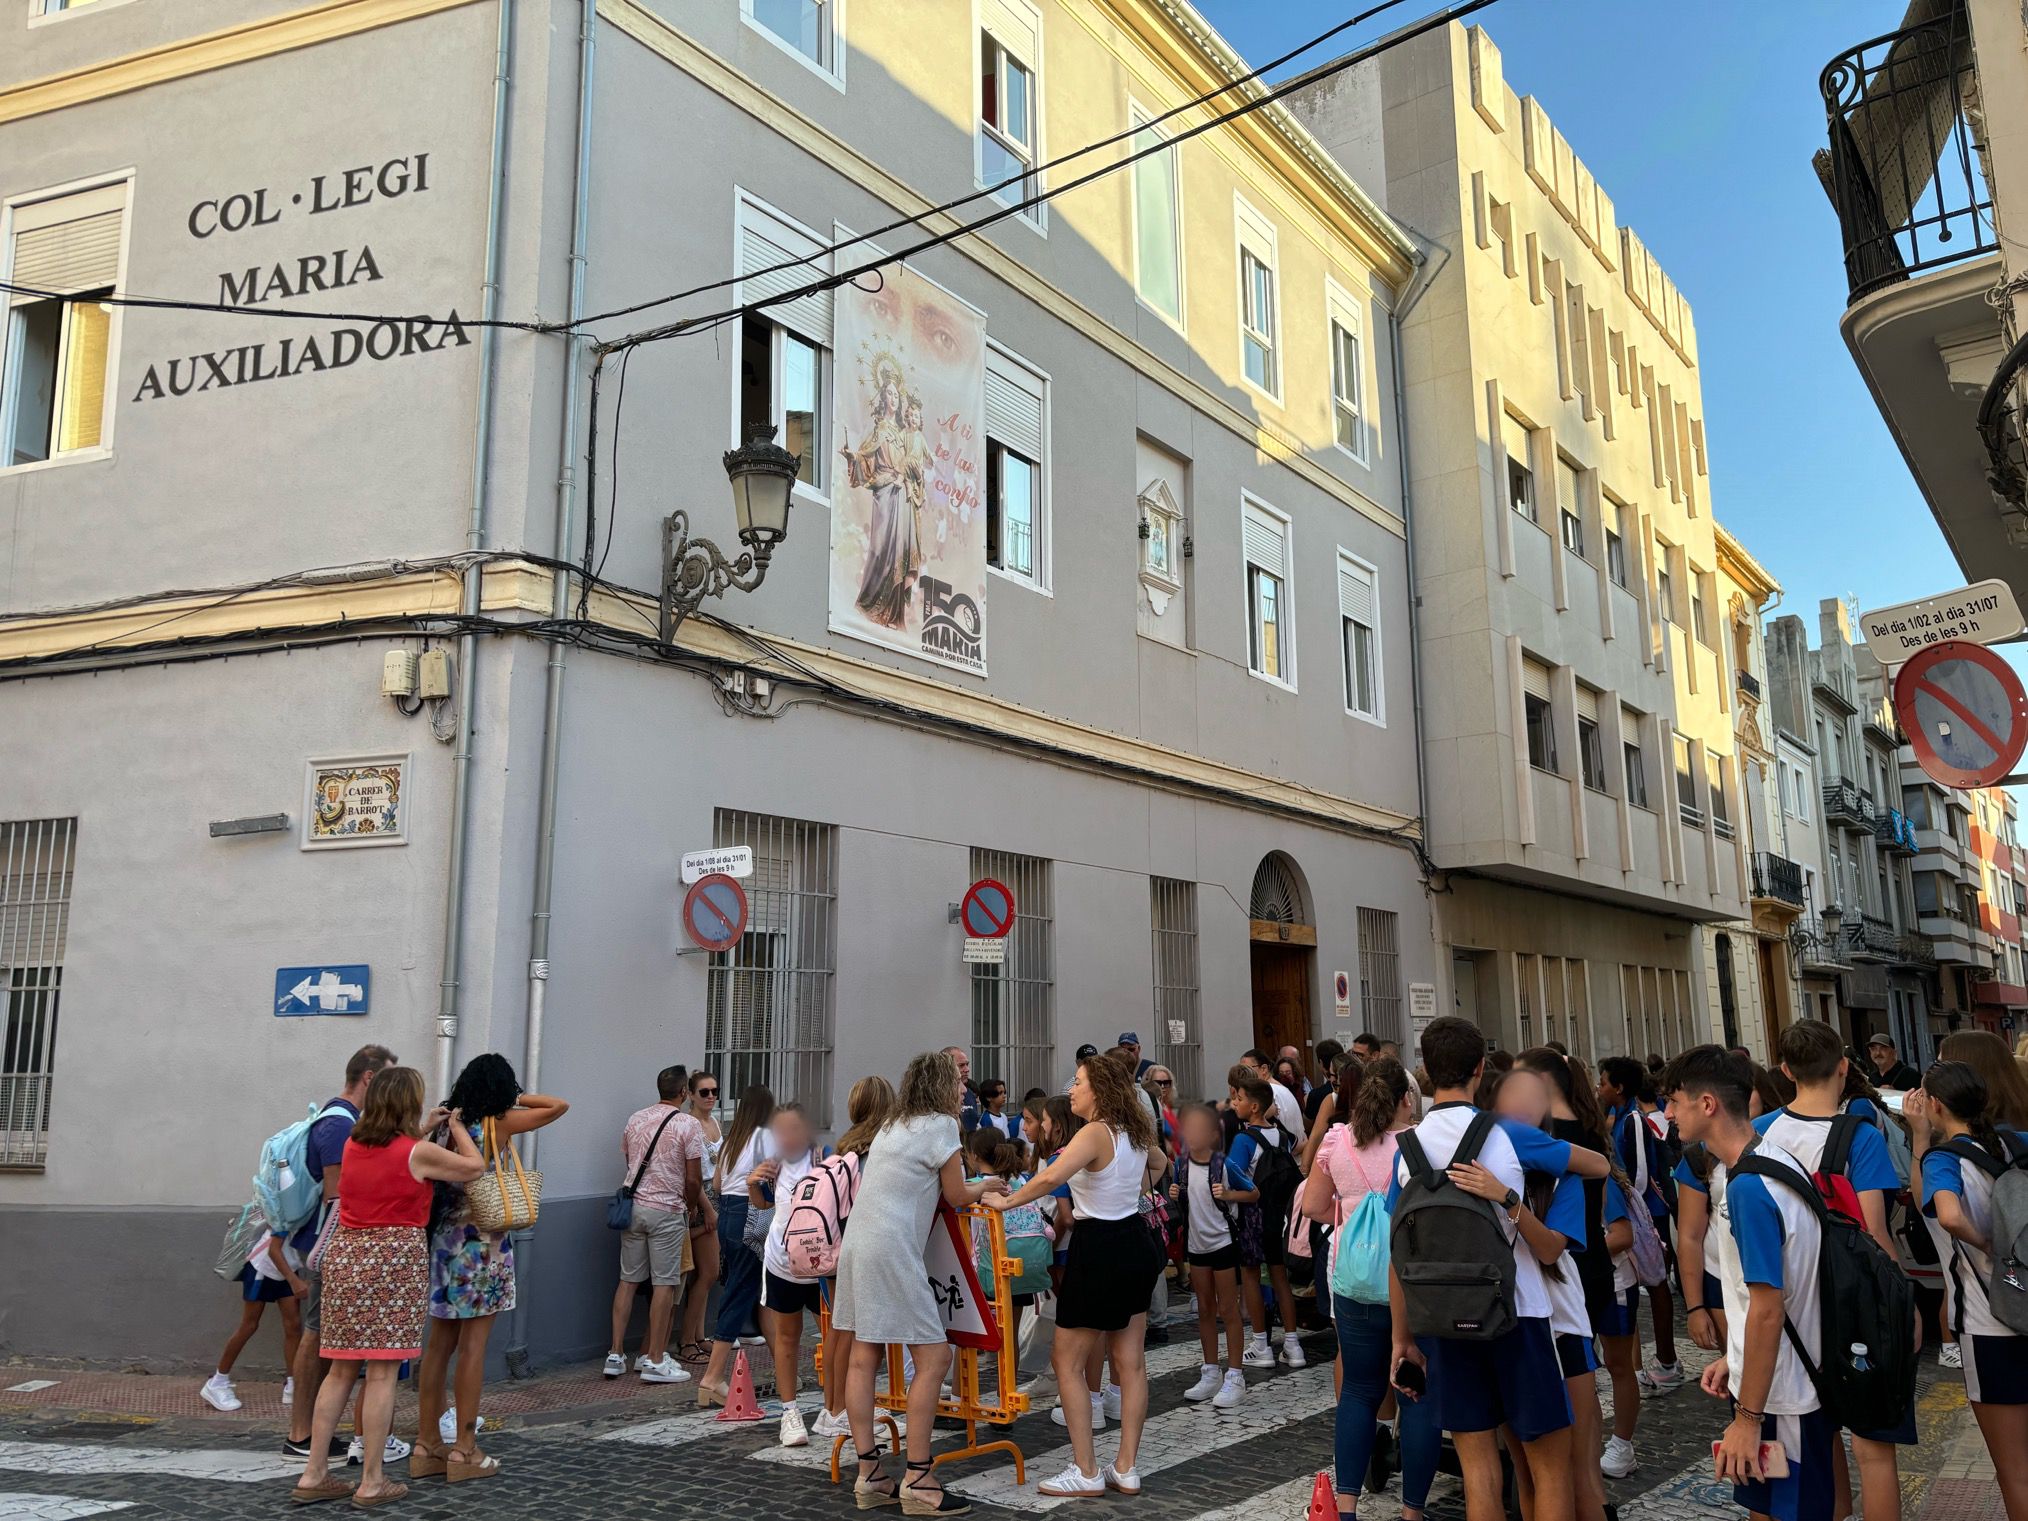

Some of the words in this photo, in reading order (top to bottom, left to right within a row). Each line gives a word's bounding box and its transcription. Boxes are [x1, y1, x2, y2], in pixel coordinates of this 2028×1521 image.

[218, 244, 384, 306] MARIA
[131, 308, 472, 403] AUXILIADORA
[919, 574, 981, 635] 150
[1871, 623, 1889, 637] Del
[1890, 620, 1907, 634] dia
[1907, 613, 1932, 630] 1/02
[1932, 610, 1945, 624] al
[1946, 606, 1966, 621] dia
[1966, 595, 1999, 615] 31/07
[921, 625, 982, 662] MARIA
[1900, 635, 1922, 648] Des
[1923, 630, 1938, 643] de
[1938, 626, 1959, 640] les
[1959, 622, 1968, 634] 9
[1969, 619, 1980, 632] h
[921, 645, 944, 658] CAMINA
[944, 653, 957, 661] POR
[348, 785, 384, 796] CARRER
[360, 796, 372, 805] DE
[348, 805, 385, 815] BARROT
[686, 860, 695, 868] Del
[716, 856, 722, 864] al
[698, 867, 709, 875] Des
[716, 865, 725, 873] les
[725, 864, 730, 872] 9
